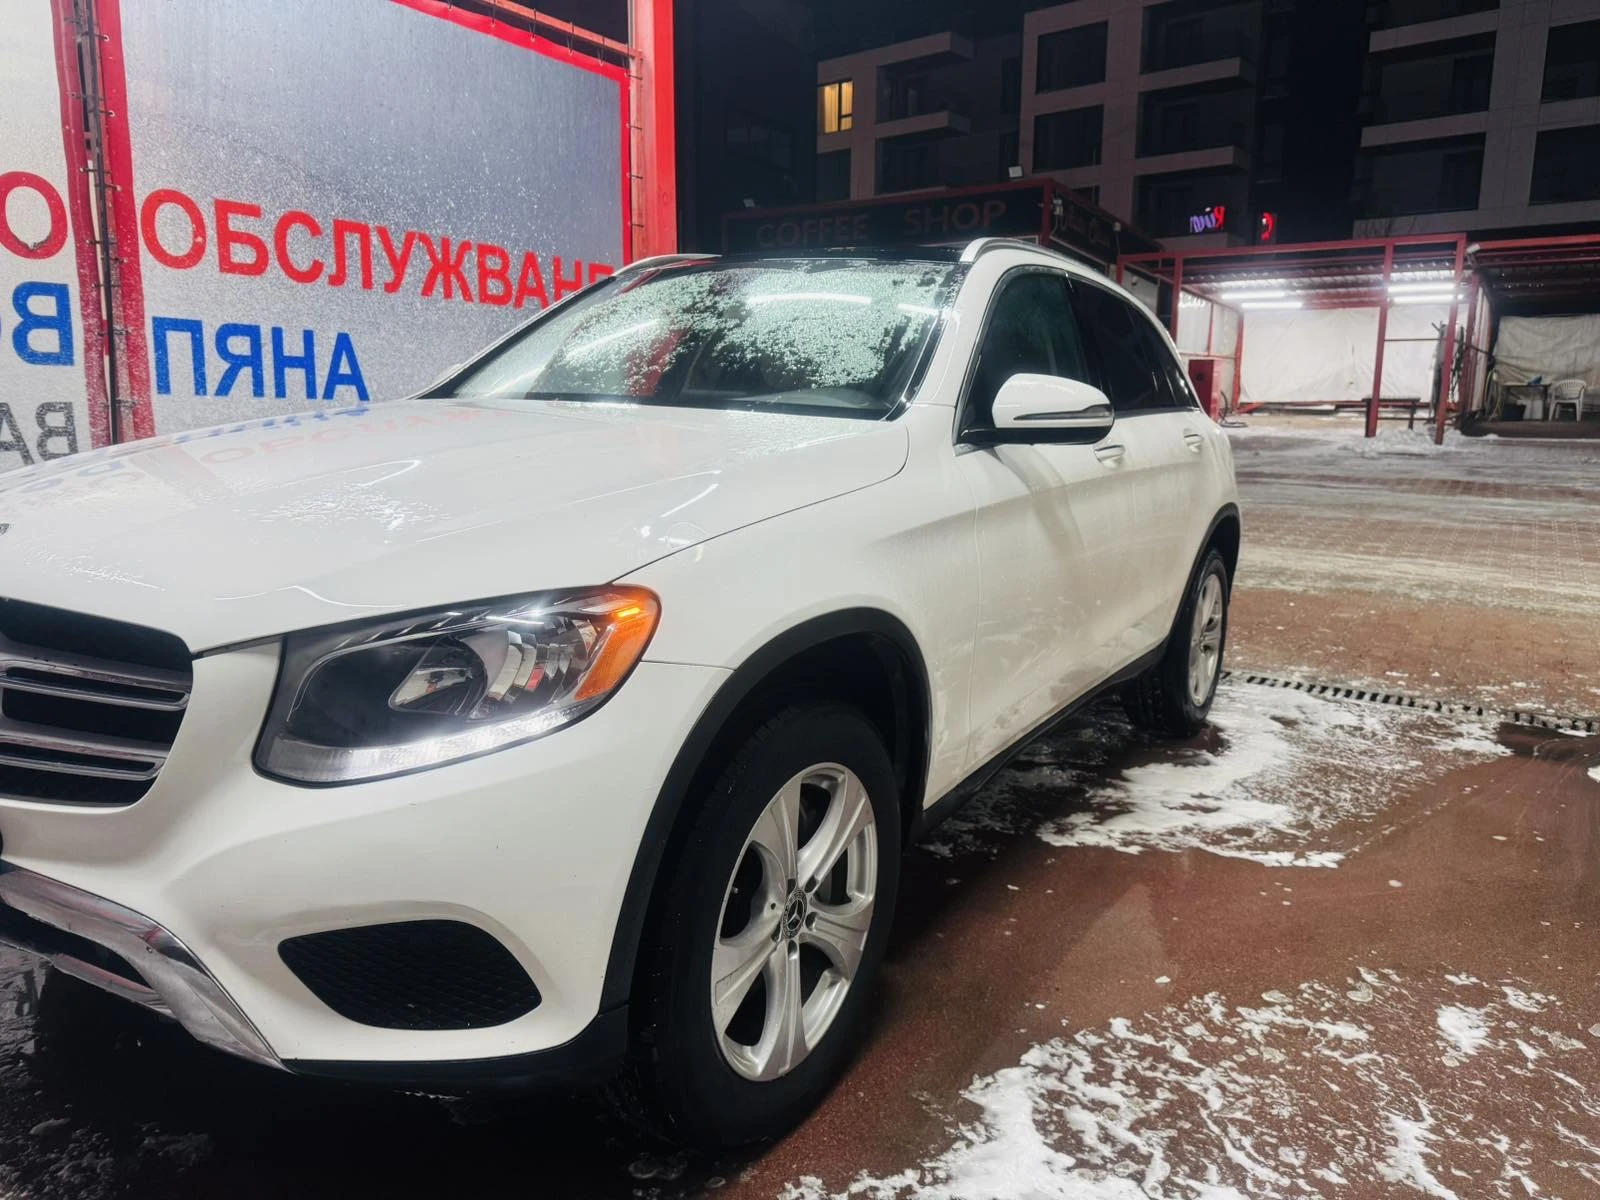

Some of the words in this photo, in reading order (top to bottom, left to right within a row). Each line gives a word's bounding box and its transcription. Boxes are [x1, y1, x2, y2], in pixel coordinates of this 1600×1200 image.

[755, 214, 871, 248] COFFEE
[903, 201, 1008, 234] SHOP
[152, 316, 370, 401] ПЯНА
